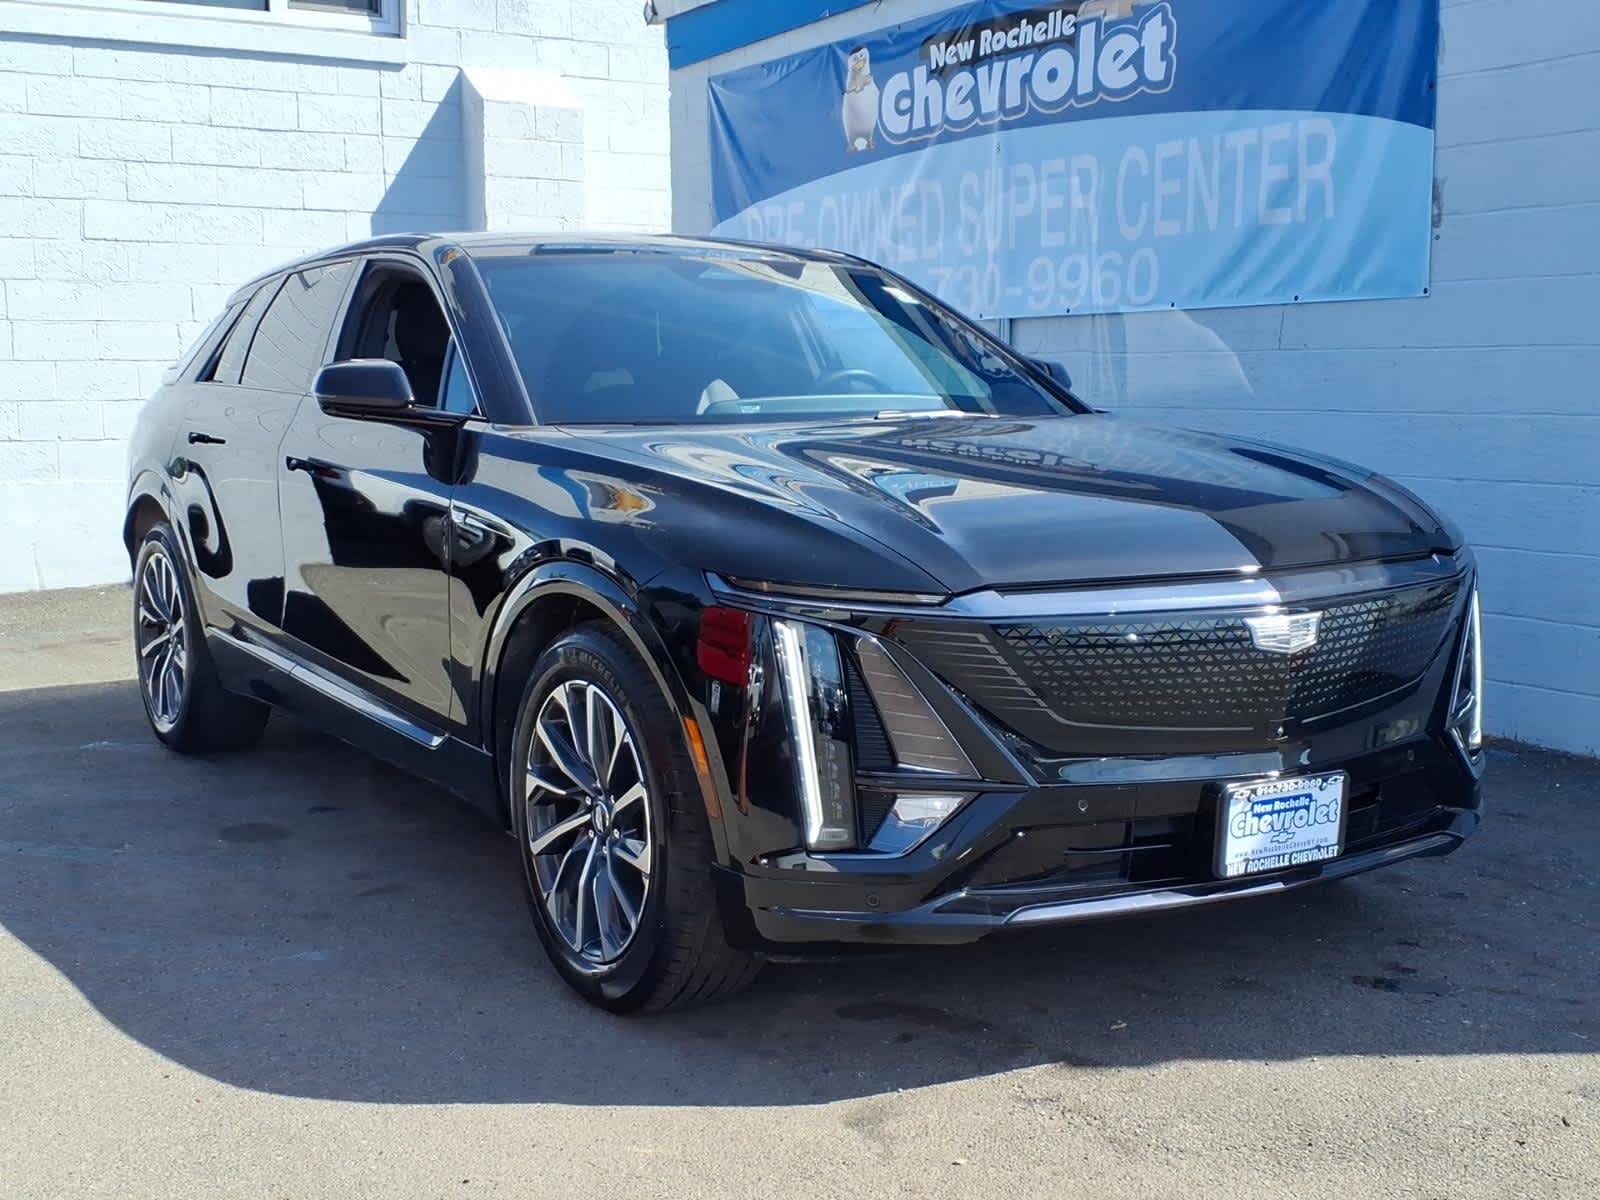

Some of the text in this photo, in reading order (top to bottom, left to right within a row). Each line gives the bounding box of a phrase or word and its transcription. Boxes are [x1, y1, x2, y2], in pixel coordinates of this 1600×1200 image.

[930, 9, 1077, 70] New Rochelle
[880, 10, 1168, 136] Chevrolet
[958, 152, 1102, 257] SUPER
[1115, 118, 1337, 241] CENTER
[1230, 799, 1339, 838] Chevrolet
[1254, 797, 1310, 814] New Rochelle
[1247, 855, 1290, 872] ROCHELLE
[1291, 845, 1339, 864] CHEVROLET
